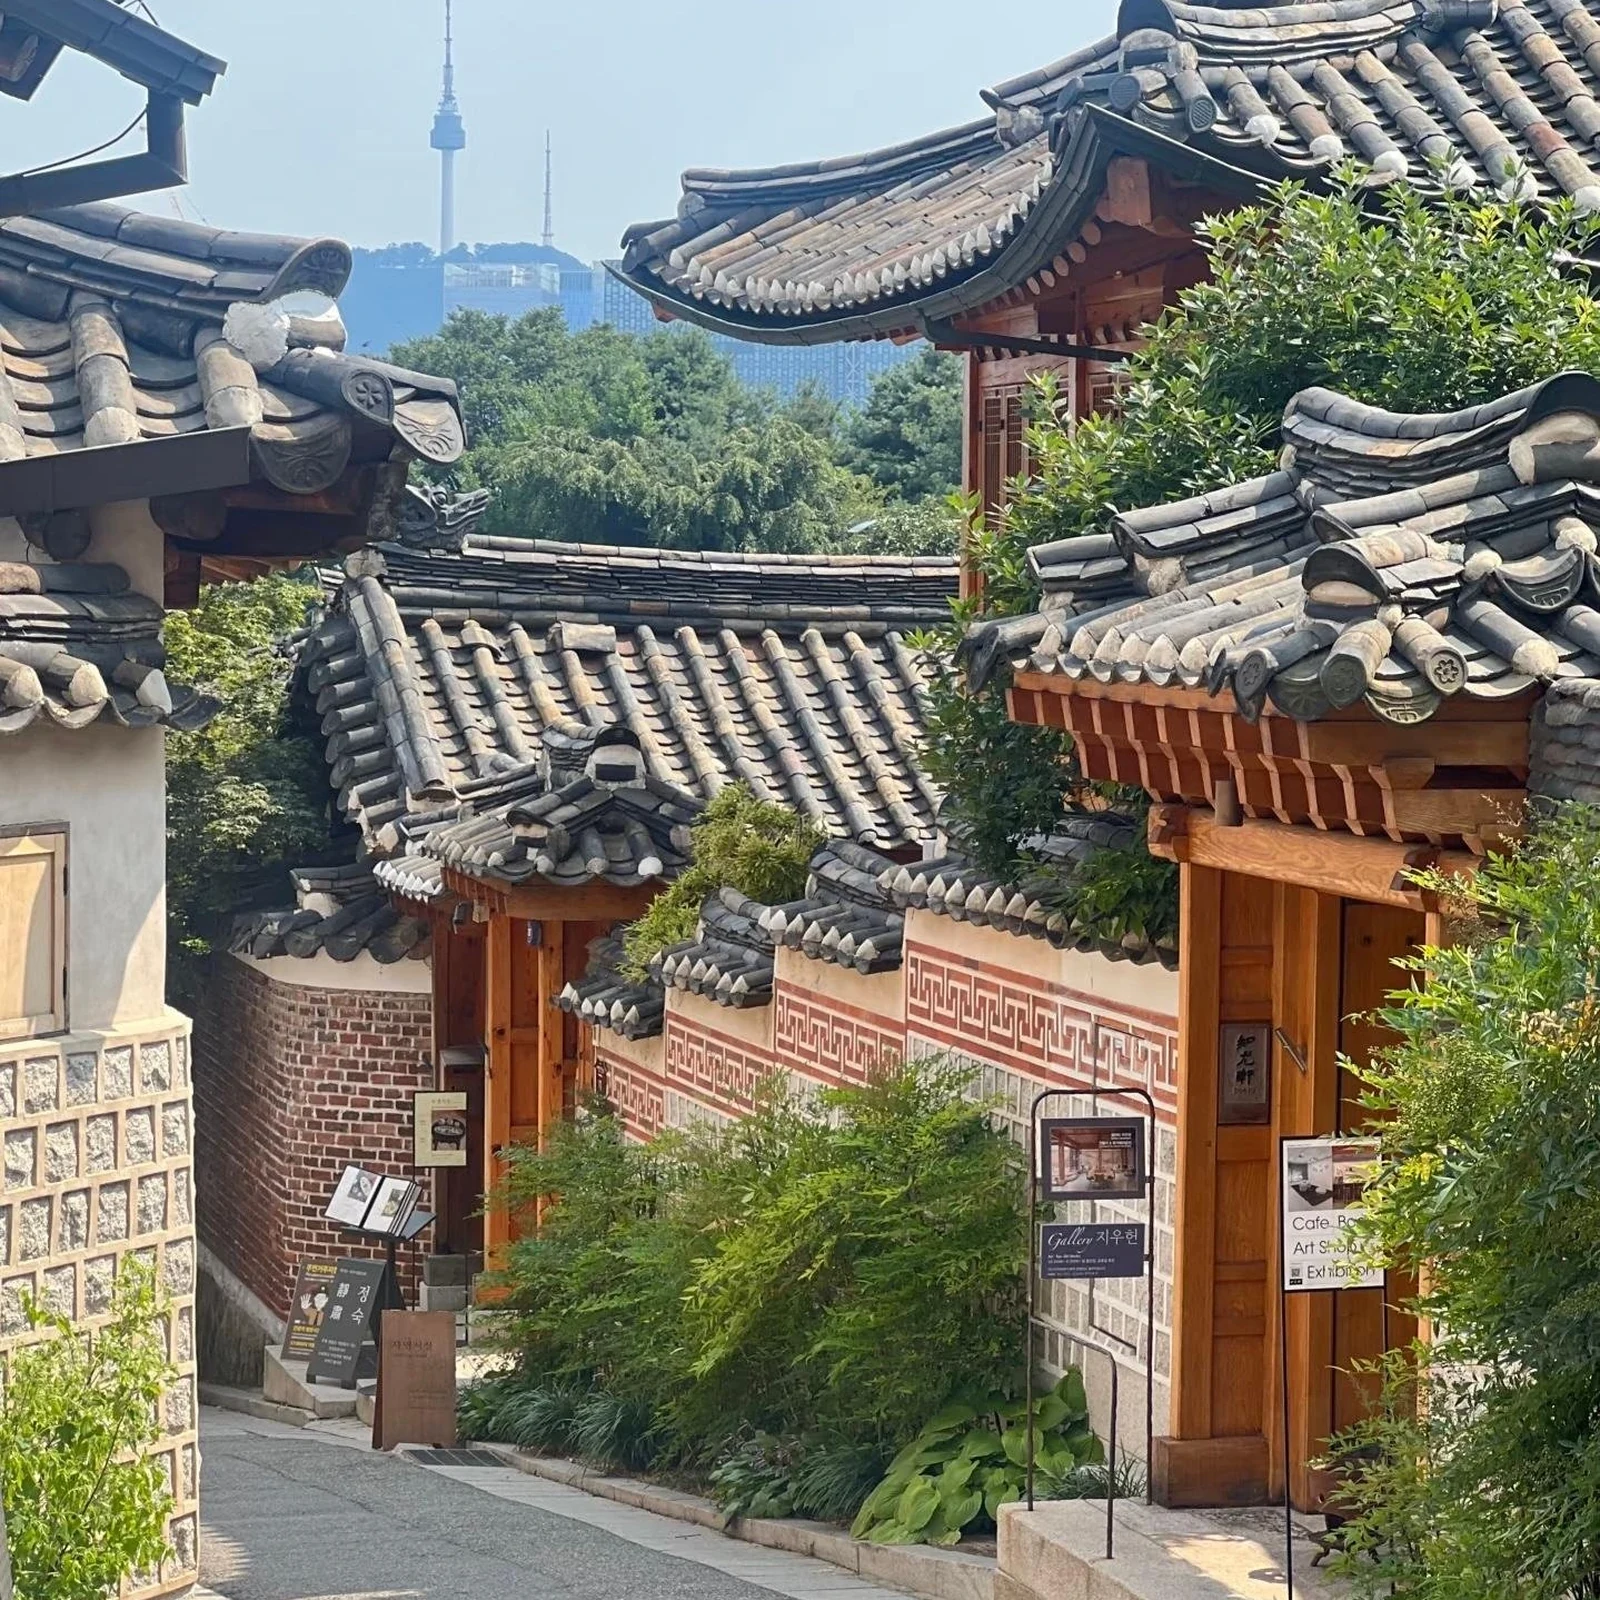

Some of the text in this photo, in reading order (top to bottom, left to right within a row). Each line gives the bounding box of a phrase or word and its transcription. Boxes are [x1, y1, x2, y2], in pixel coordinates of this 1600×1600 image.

[1292, 1215, 1329, 1231] Cafe
[1047, 1226, 1138, 1254] Gallery 지우헌
[1293, 1241, 1314, 1255] Art
[351, 1285, 371, 1325] 정숙
